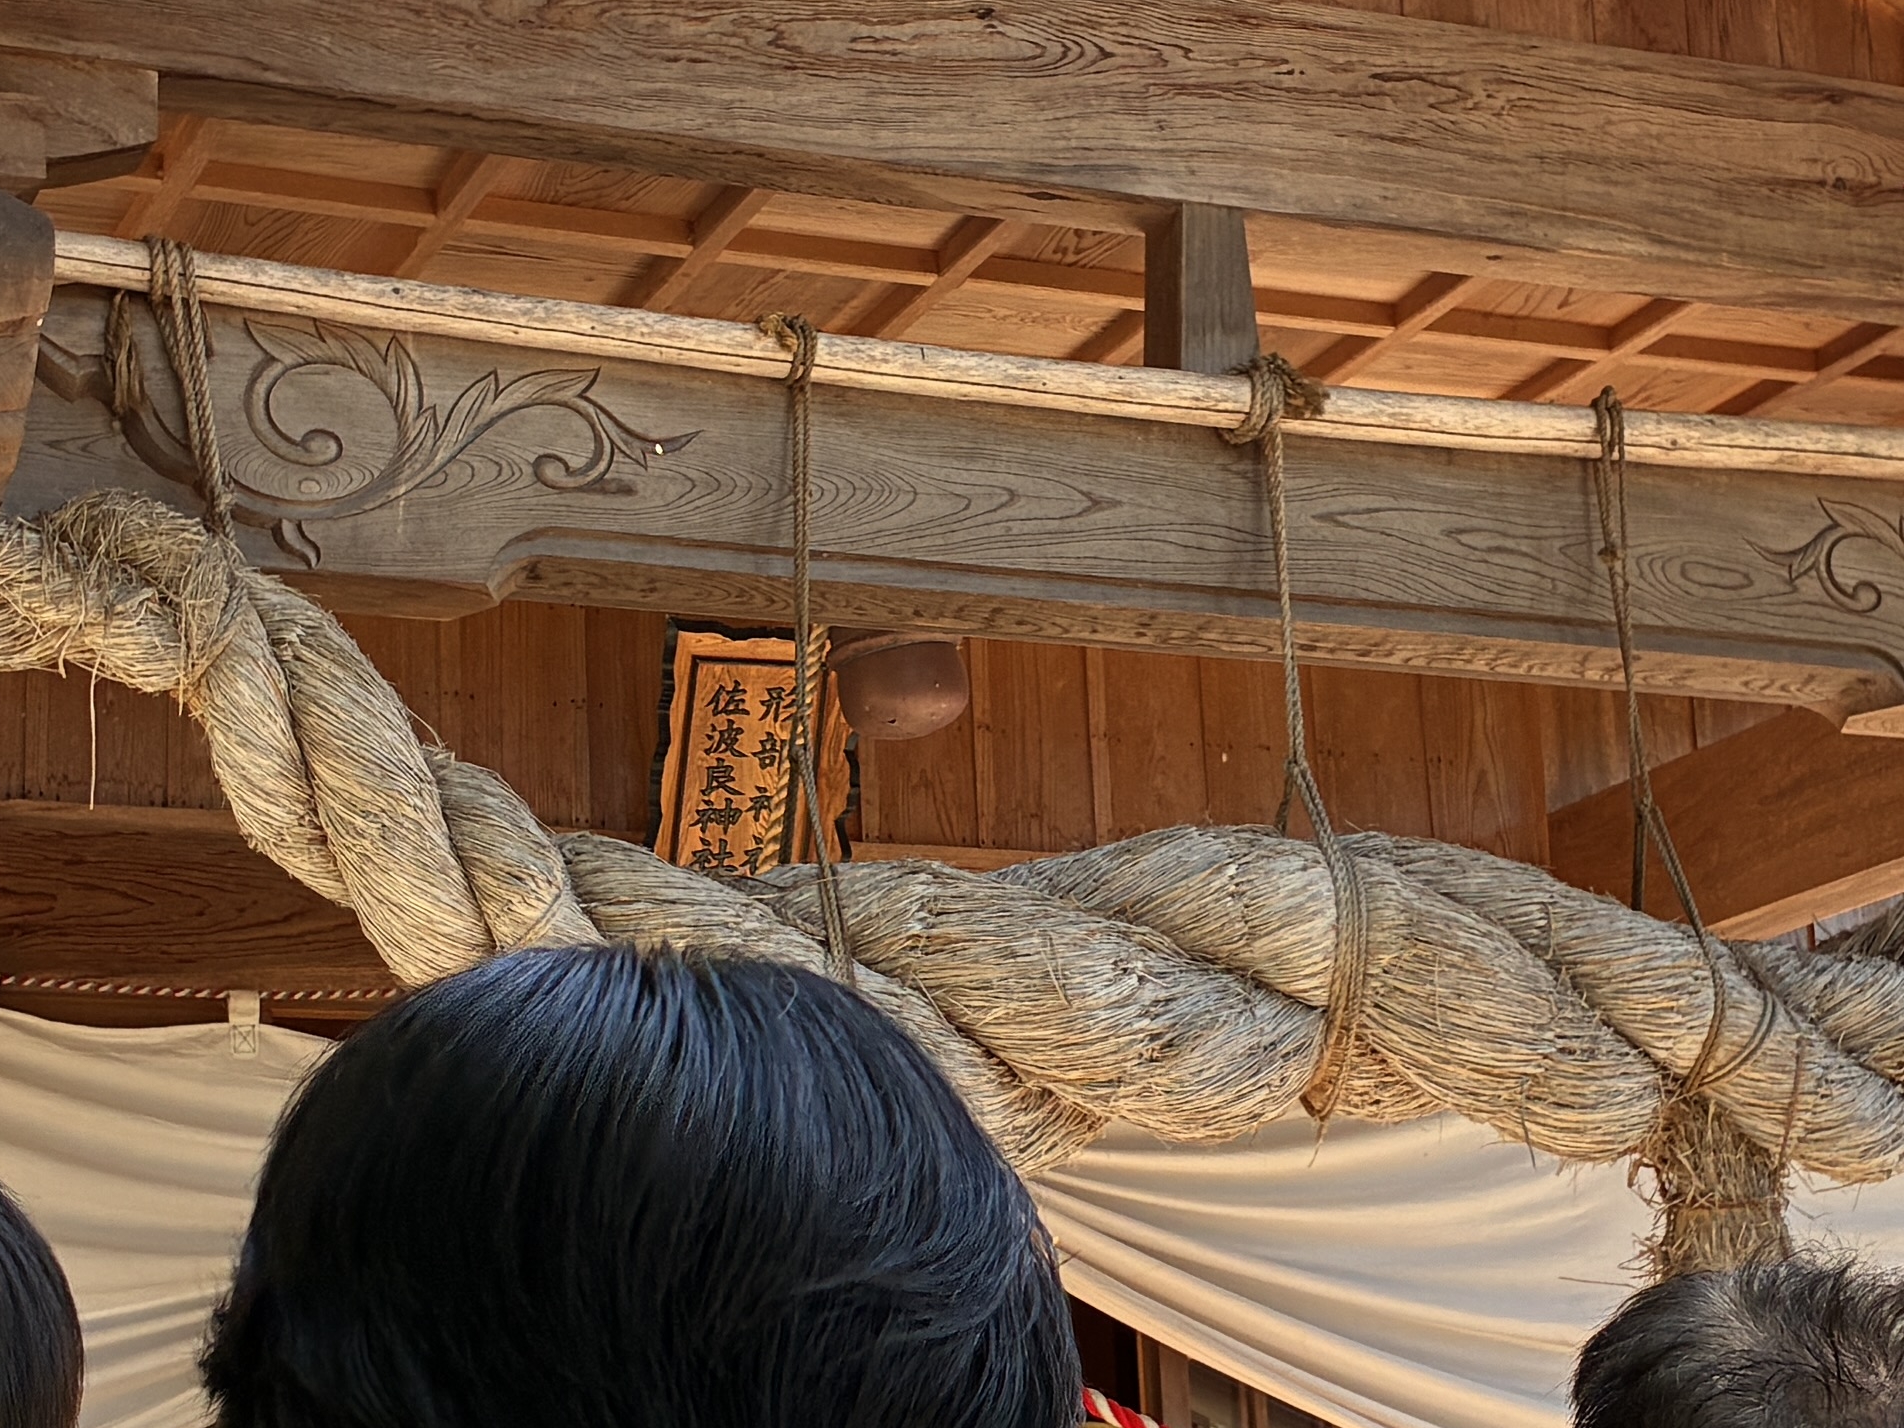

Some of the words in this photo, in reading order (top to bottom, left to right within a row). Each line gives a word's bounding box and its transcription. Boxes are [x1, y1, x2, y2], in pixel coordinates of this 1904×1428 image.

[689, 679, 751, 873] 佐波良神社
